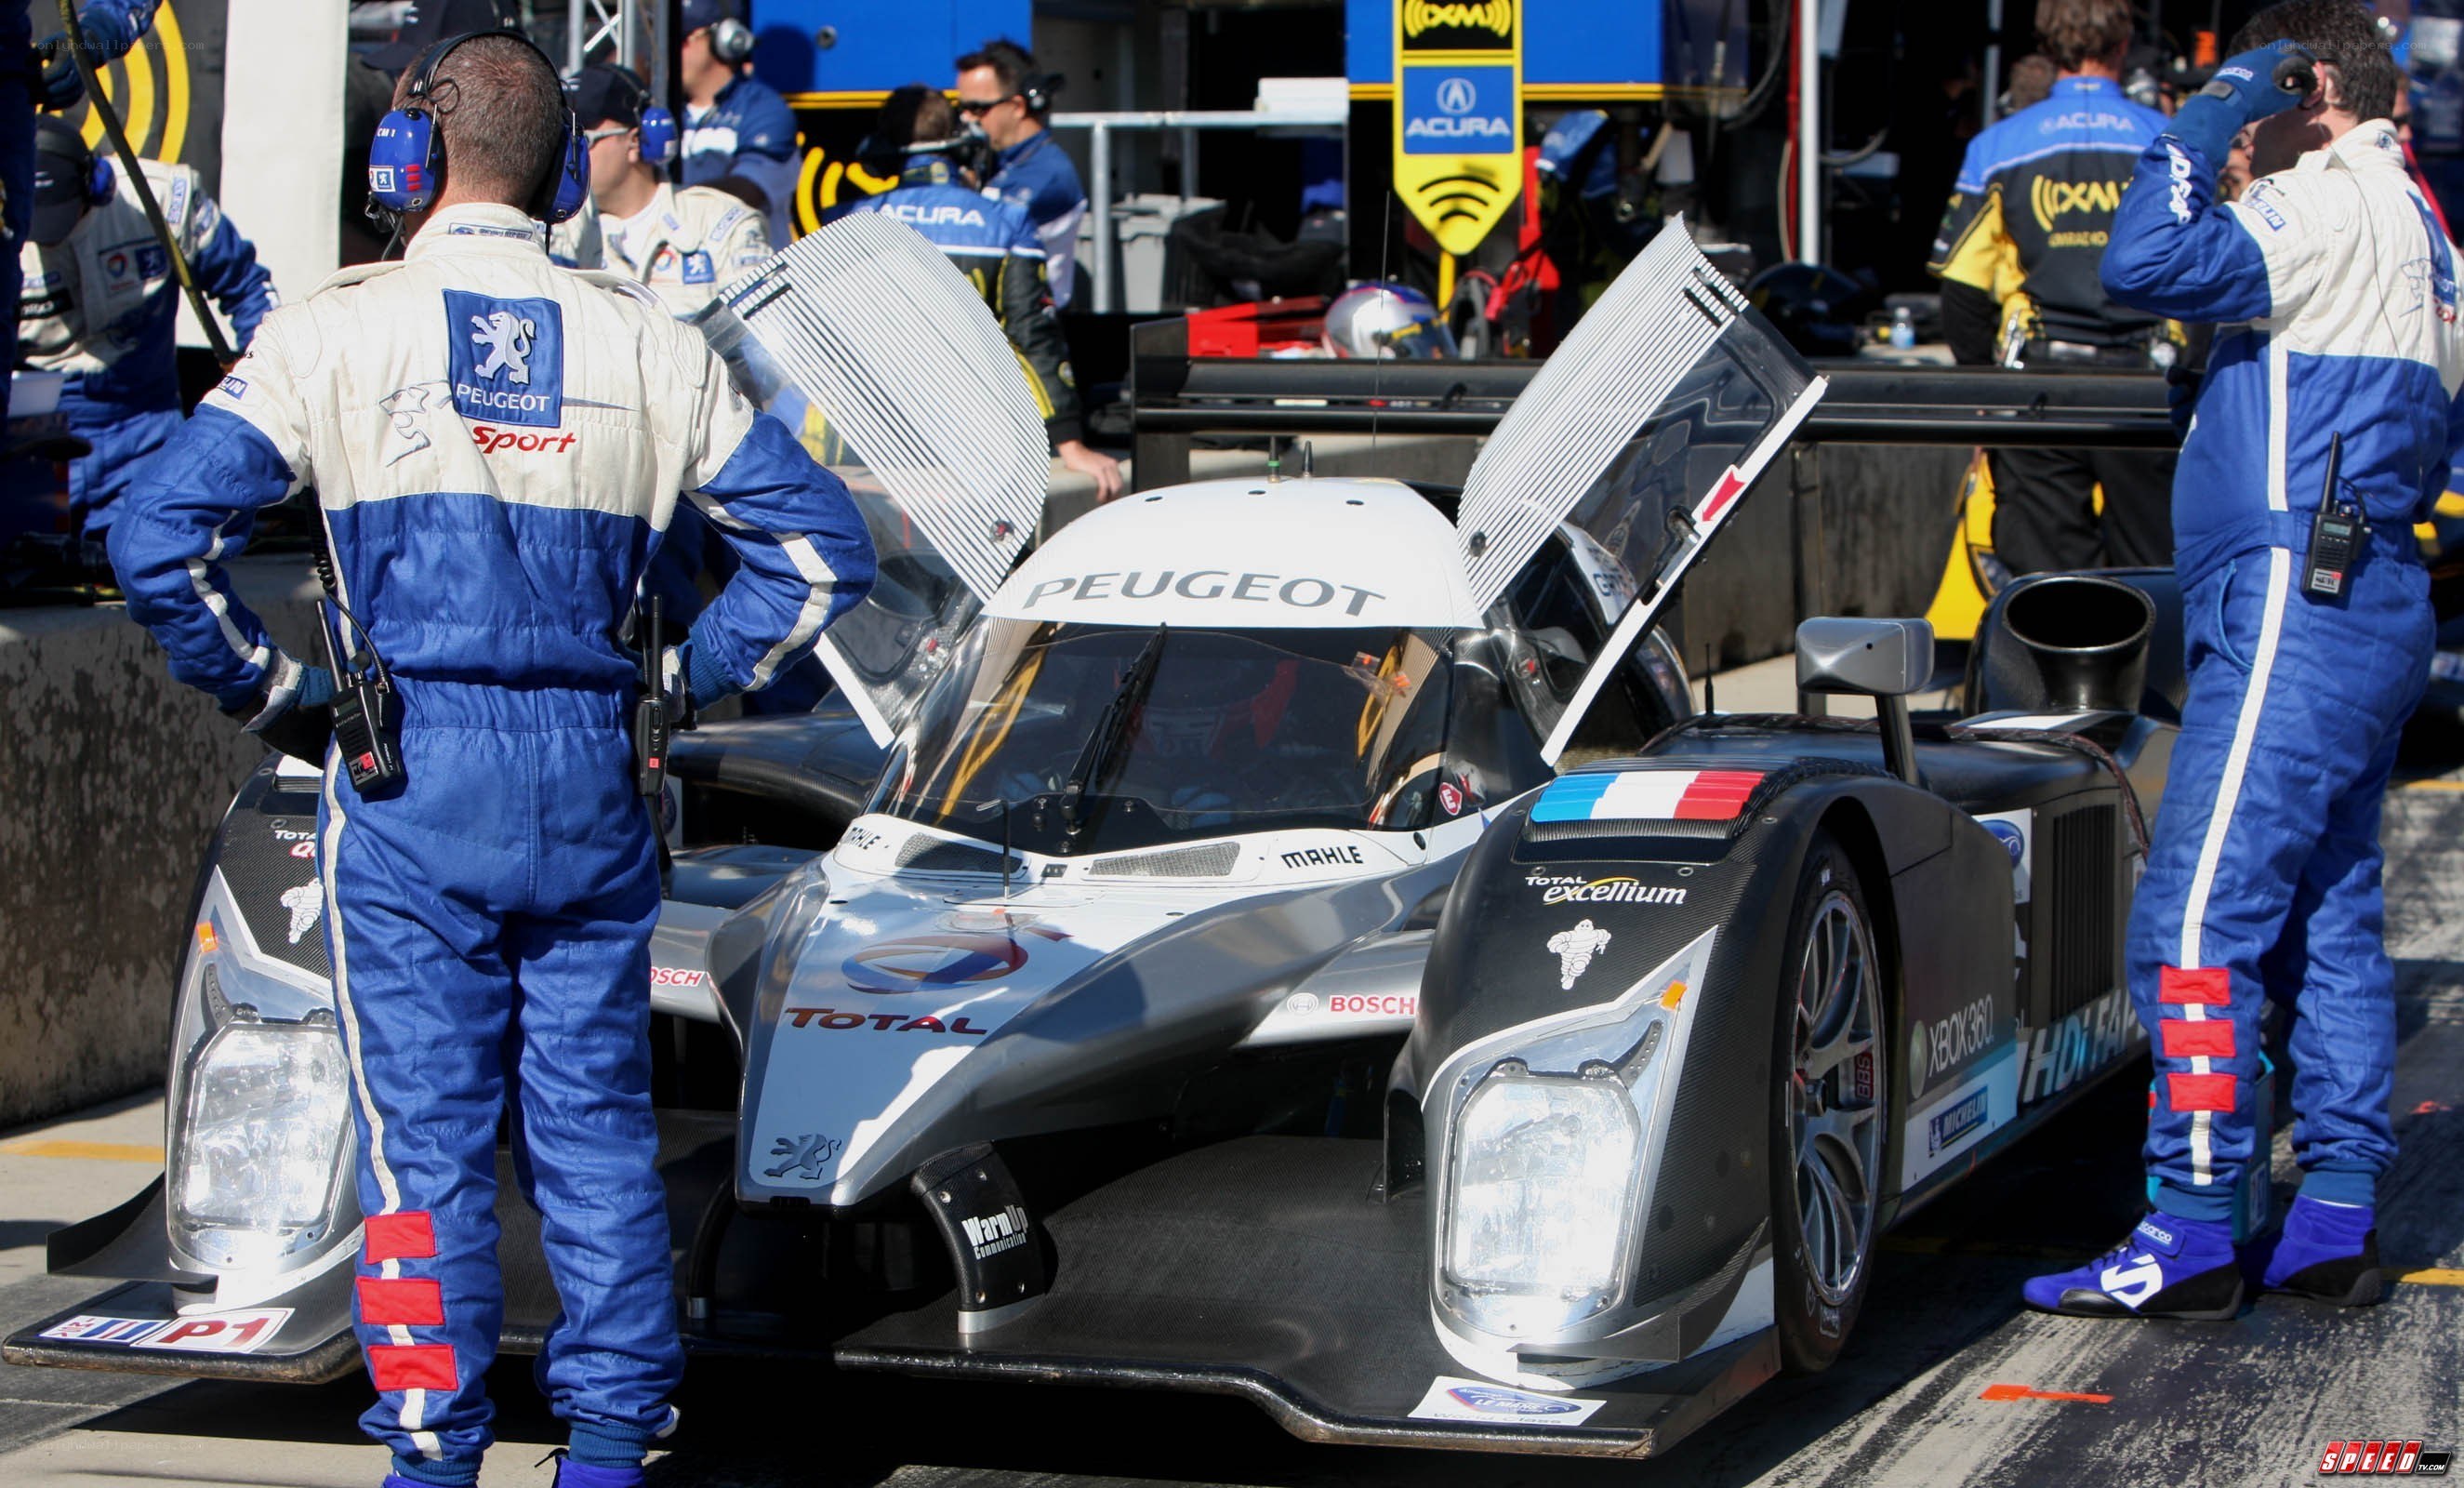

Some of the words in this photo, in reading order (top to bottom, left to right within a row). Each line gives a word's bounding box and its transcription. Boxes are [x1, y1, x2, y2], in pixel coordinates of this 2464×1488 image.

[1405, 117, 1511, 138] ACURA
[2056, 112, 2136, 132] ACURA
[878, 203, 987, 227] ACURA
[456, 383, 550, 412] PEUGEOT
[1023, 570, 1385, 617] PEUGEOT
[1280, 845, 1363, 869] MAHLE
[1525, 876, 1588, 886] TOTAL
[1543, 881, 1688, 905] excellium
[1330, 996, 1415, 1016] BOSCH
[785, 1007, 987, 1036] TOTAL
[1943, 1090, 1988, 1137] MICHELIN
[156, 1317, 271, 1348] P1
